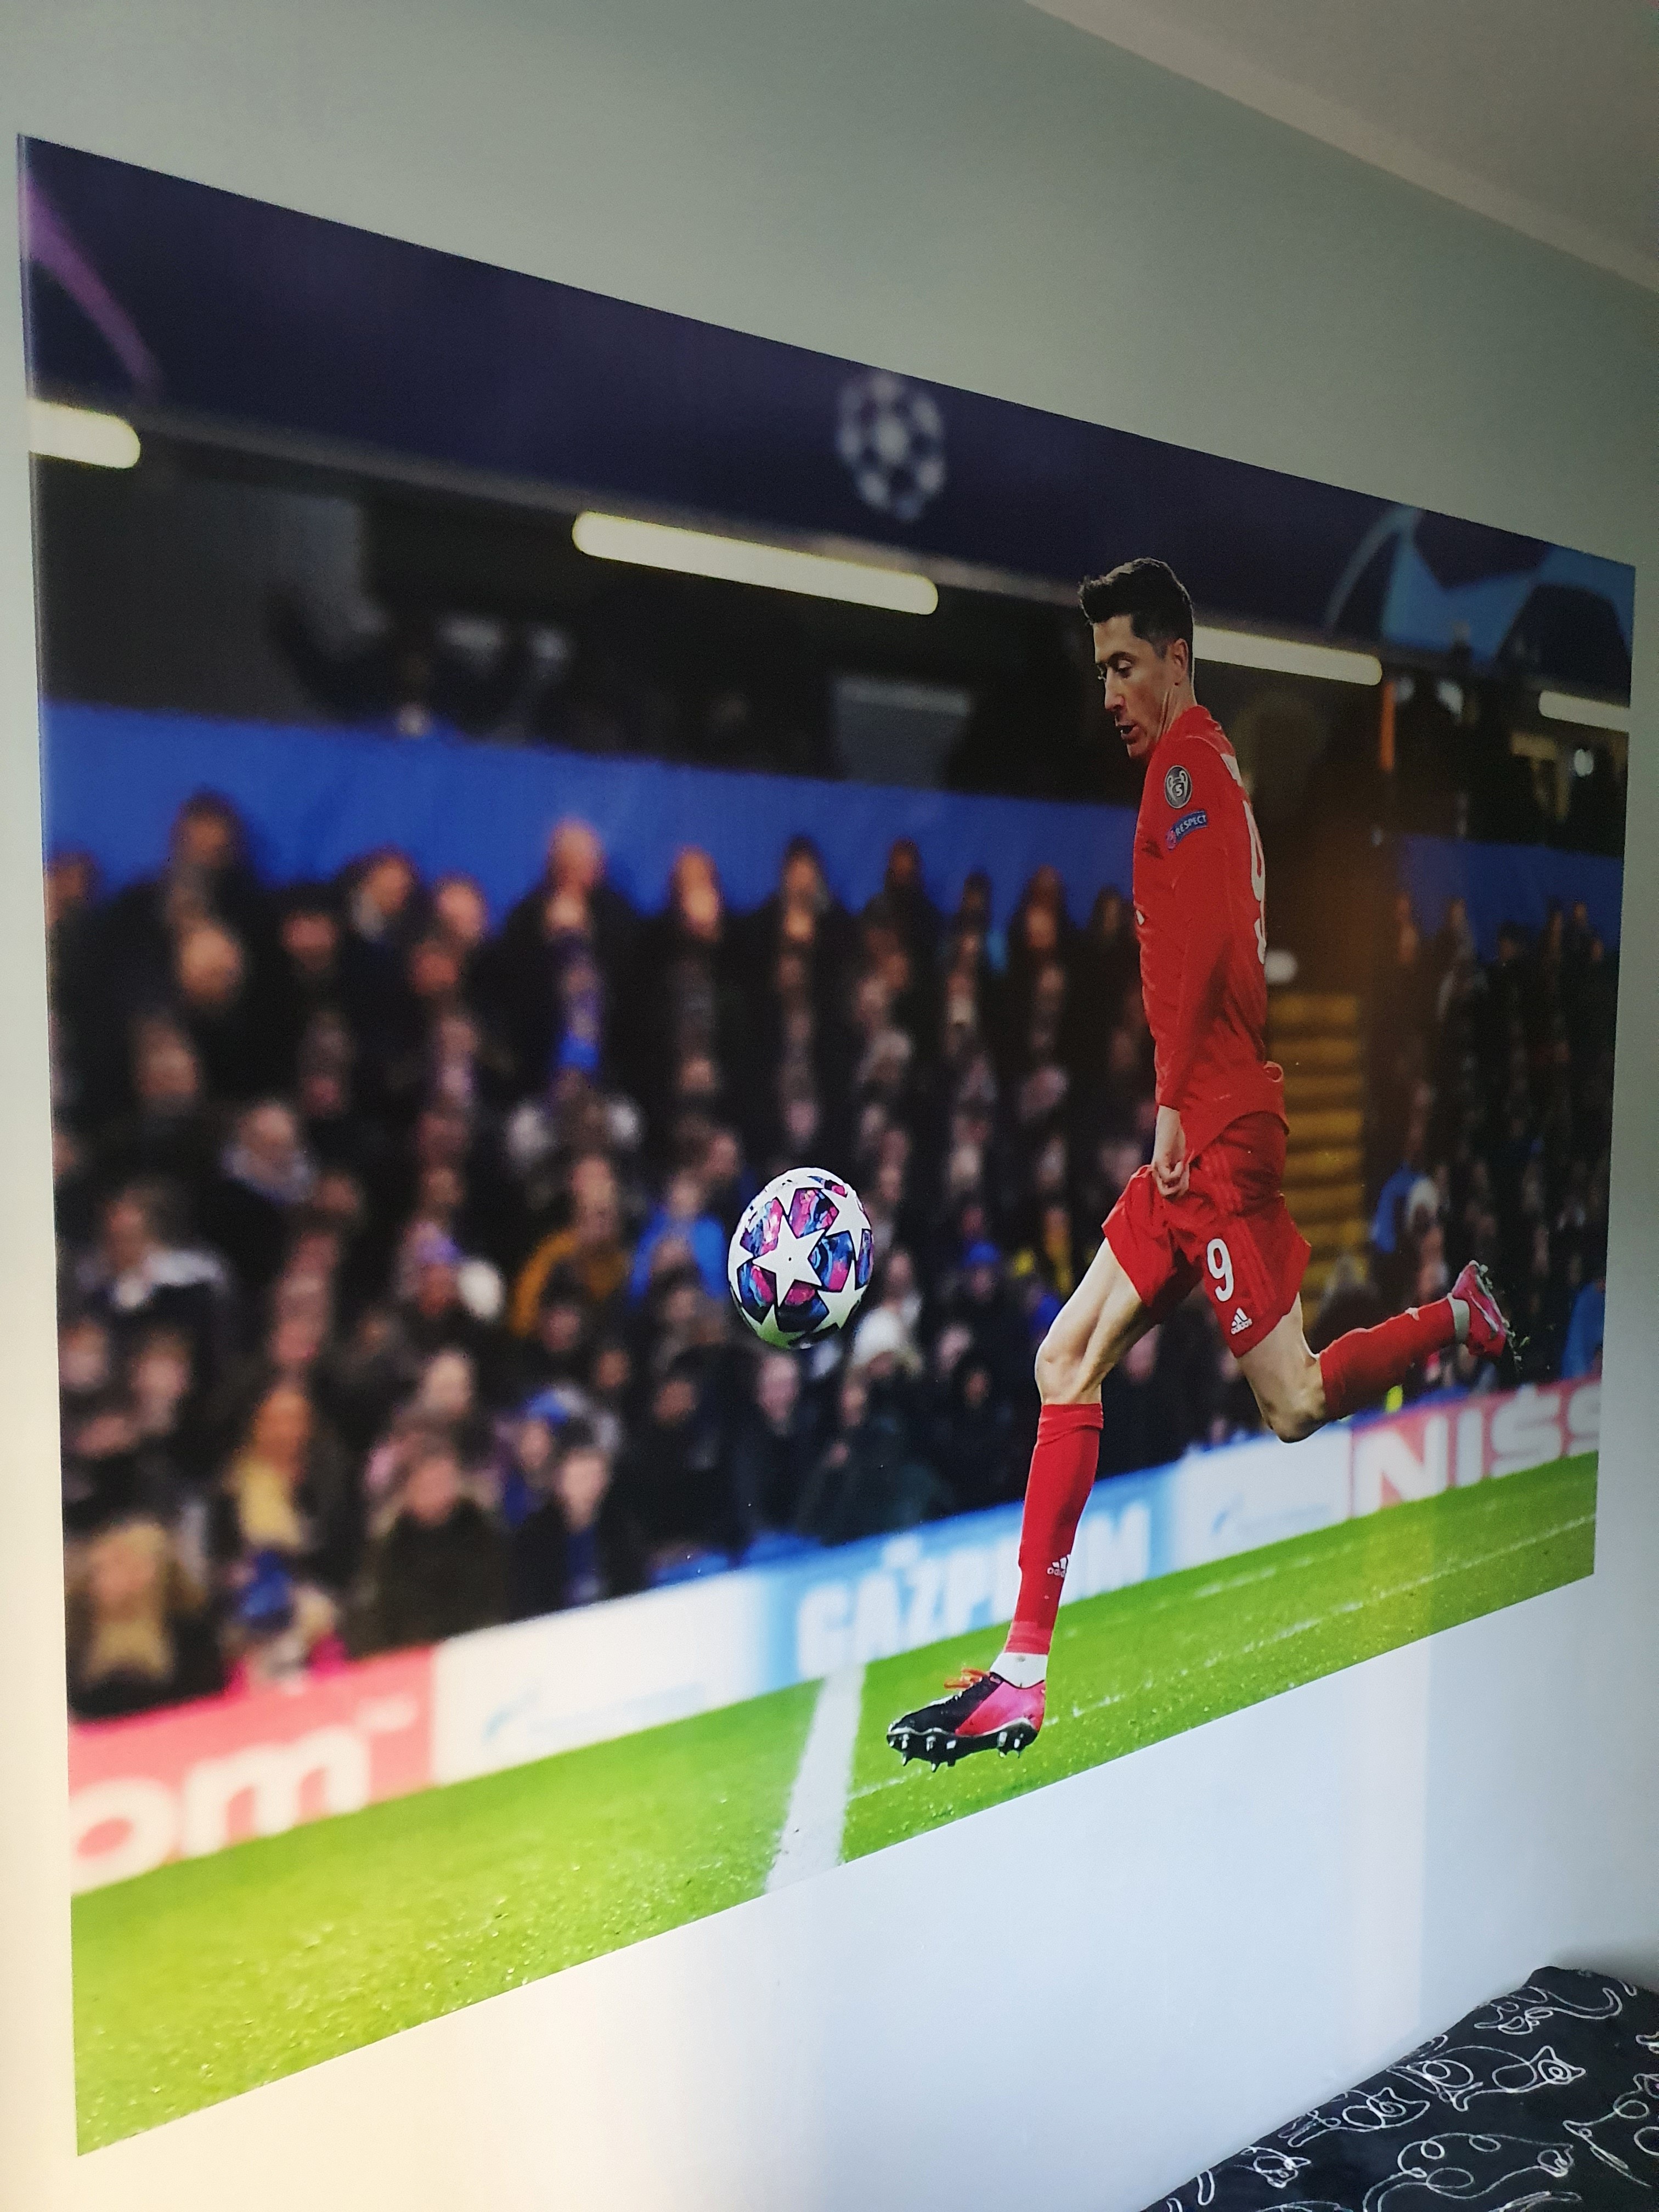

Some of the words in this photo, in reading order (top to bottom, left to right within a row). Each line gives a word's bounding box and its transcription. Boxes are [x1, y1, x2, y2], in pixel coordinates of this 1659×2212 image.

[1175, 784, 1183, 797] 5
[1175, 815, 1207, 837] RESPECT
[1207, 1238, 1234, 1302] 9
